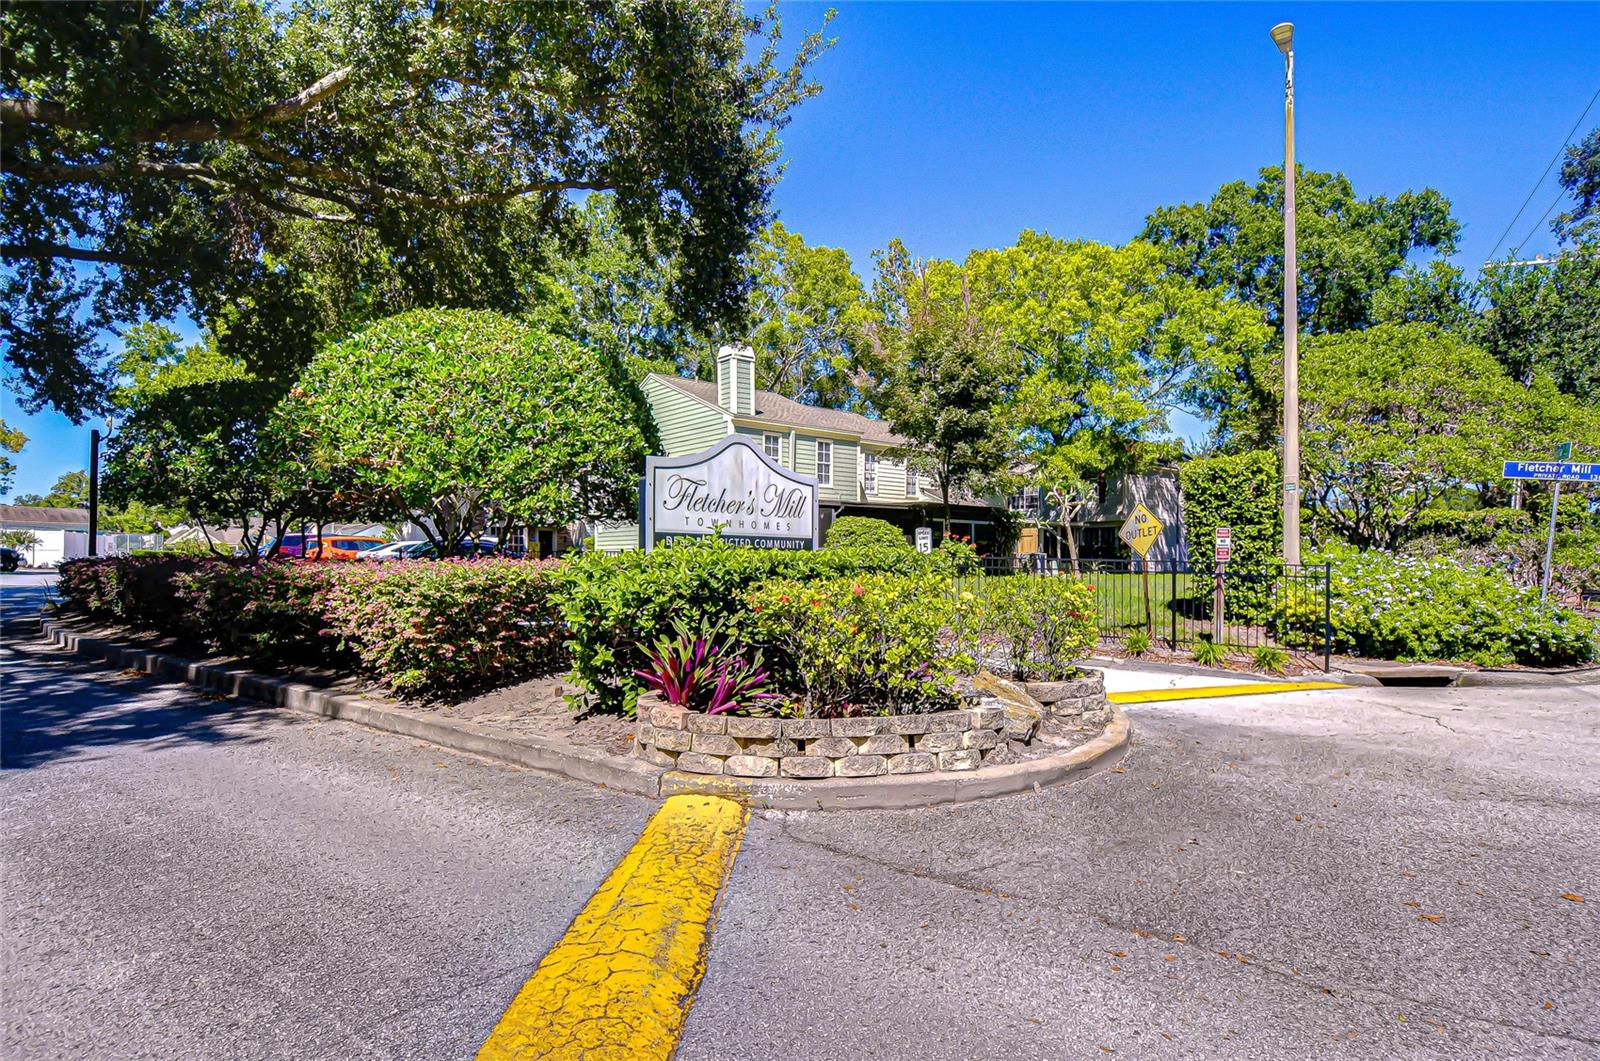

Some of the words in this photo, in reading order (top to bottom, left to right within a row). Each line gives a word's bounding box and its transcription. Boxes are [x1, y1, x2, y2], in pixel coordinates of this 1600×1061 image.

[1518, 463, 1564, 473] Fletcher
[1571, 464, 1592, 474] Mill
[663, 473, 756, 516] Fletcher's
[760, 483, 807, 519] Mill
[685, 516, 792, 531] TOWNHOMES
[1135, 514, 1147, 525] NO
[1125, 525, 1158, 540] OUTLET
[754, 539, 805, 549] COMMUNITY
[919, 543, 928, 552] 15
